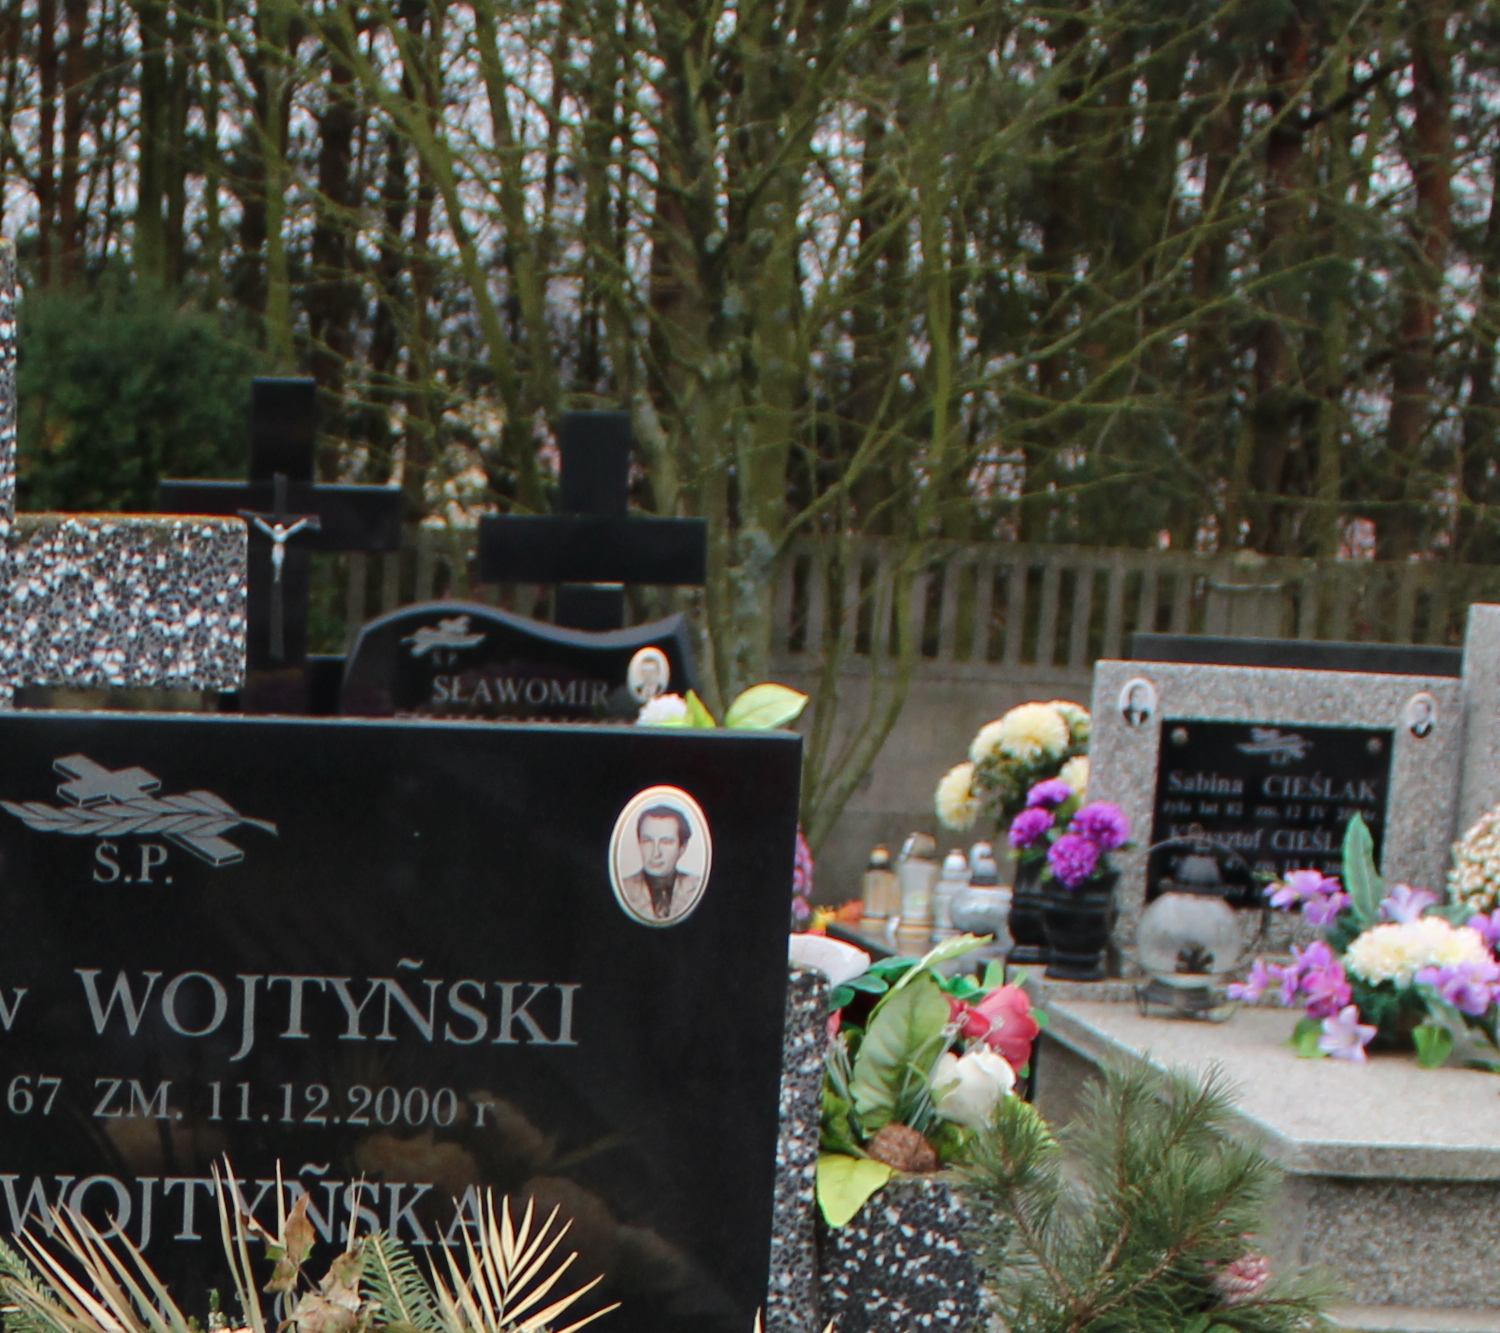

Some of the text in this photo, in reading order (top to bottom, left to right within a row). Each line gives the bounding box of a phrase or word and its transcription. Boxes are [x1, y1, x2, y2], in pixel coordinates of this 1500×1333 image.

[431, 674, 609, 706] SŁAWOMIR
[1167, 771, 1379, 801] Sabina CIEŚLAK
[6, 1073, 62, 1116] 67
[92, 1077, 184, 1121] ZM.
[207, 1080, 459, 1127] 11.12.2000
[472, 1098, 496, 1127] r
